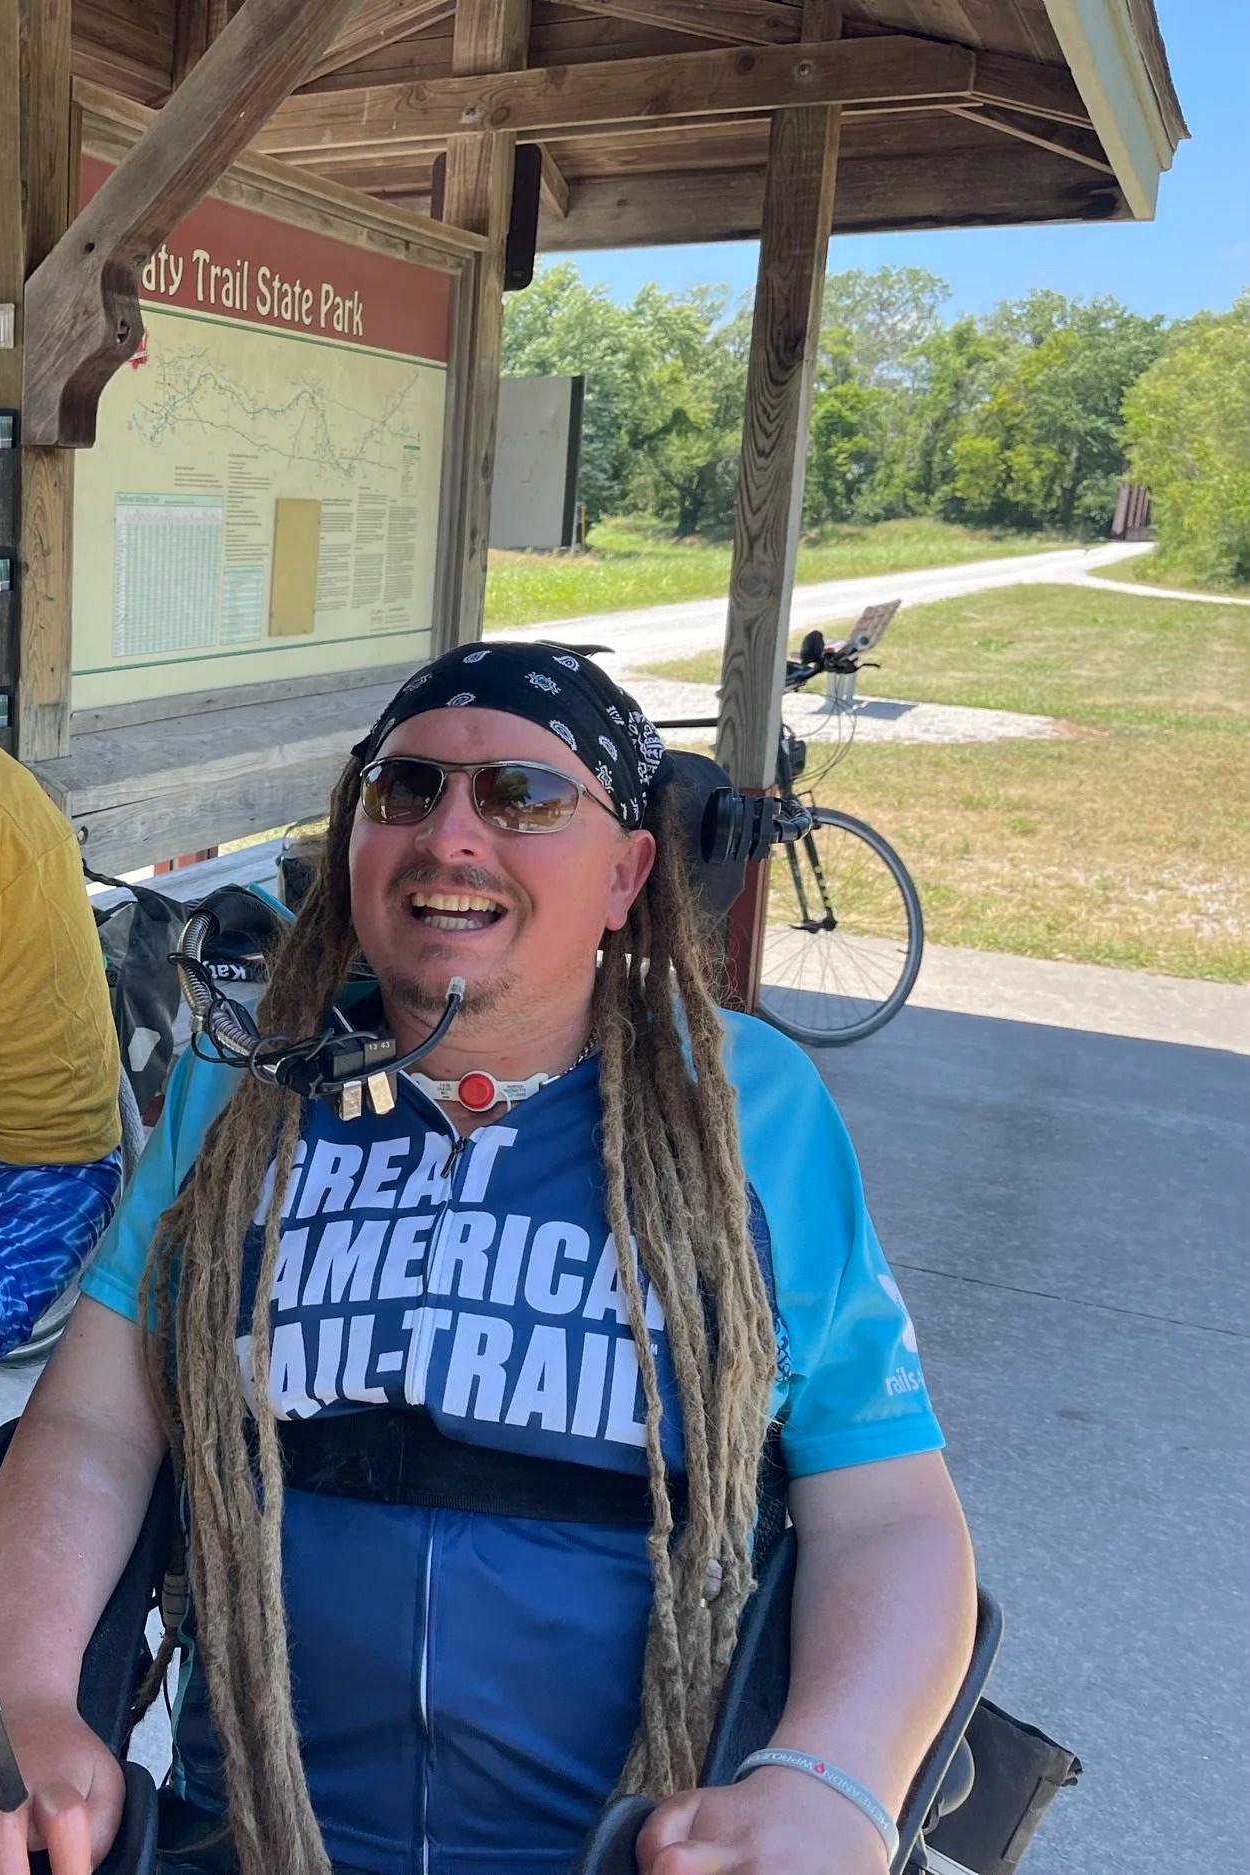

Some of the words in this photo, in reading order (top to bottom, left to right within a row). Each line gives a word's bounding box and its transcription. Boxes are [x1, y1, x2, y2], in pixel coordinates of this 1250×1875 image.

[141, 244, 183, 296] aty
[192, 249, 249, 311] Trail
[256, 266, 313, 326] State
[320, 283, 363, 336] Park
[252, 1126, 519, 1226] GREAT
[268, 1208, 666, 1331] AMERICA
